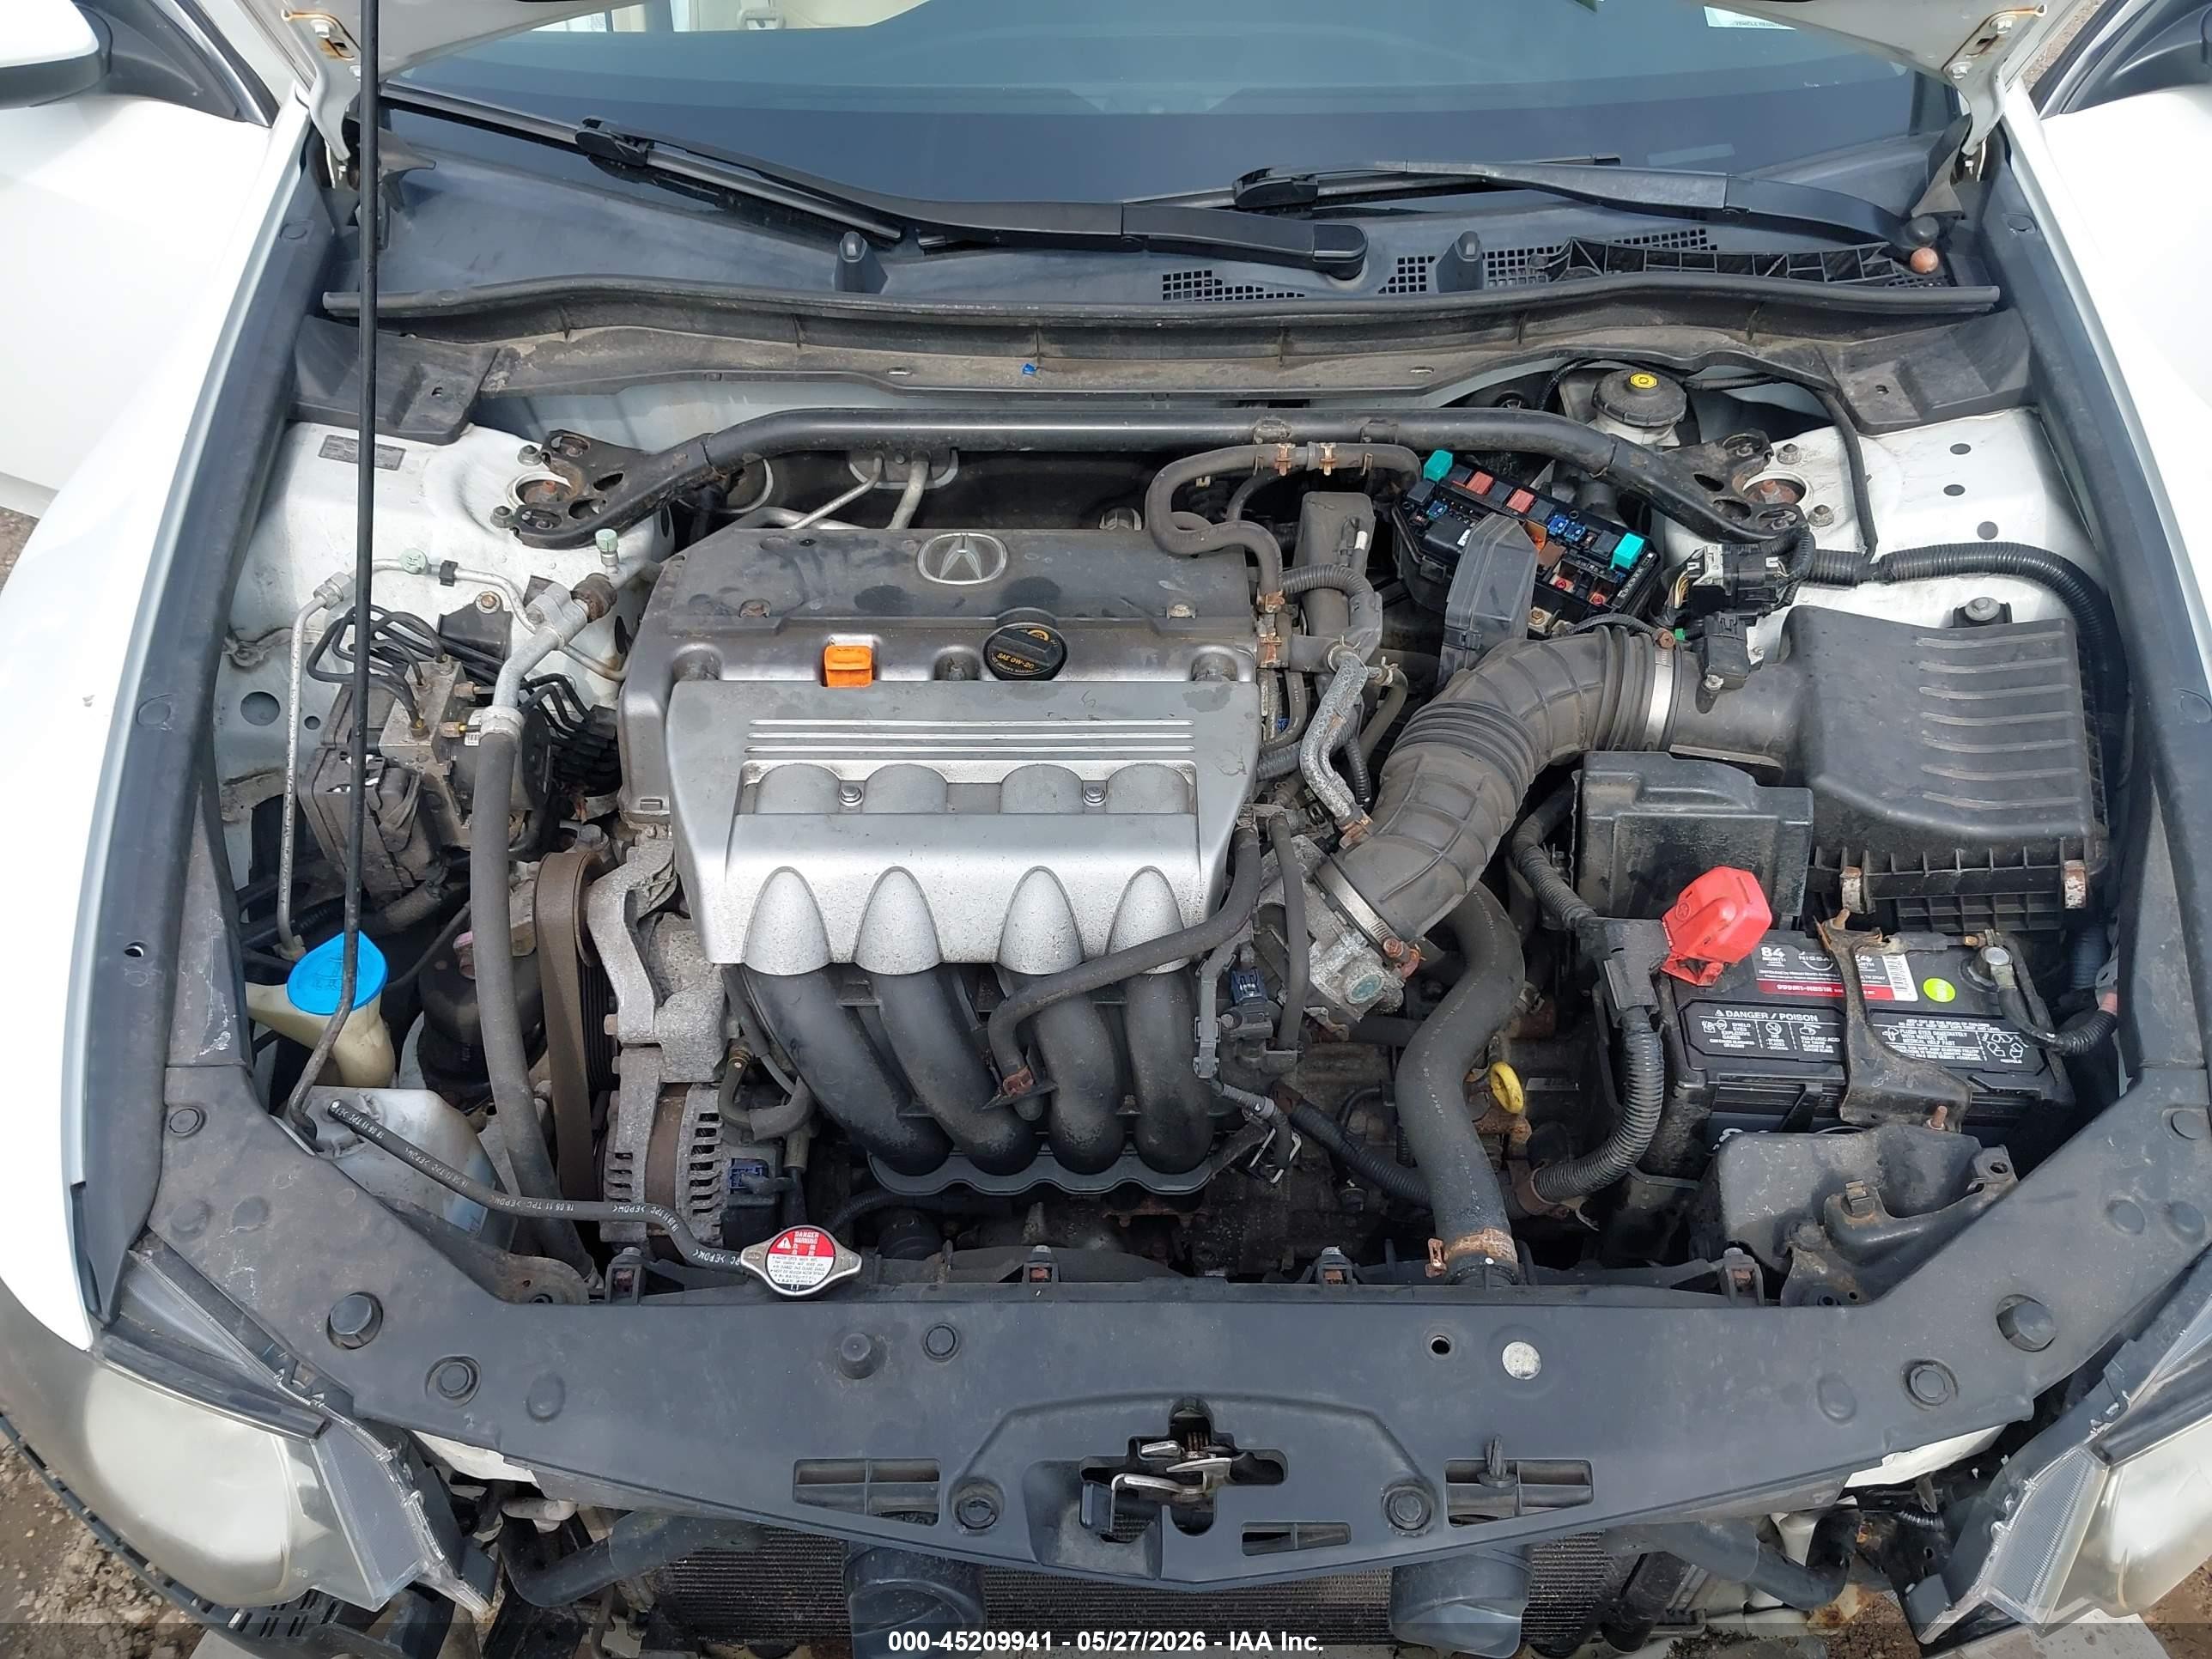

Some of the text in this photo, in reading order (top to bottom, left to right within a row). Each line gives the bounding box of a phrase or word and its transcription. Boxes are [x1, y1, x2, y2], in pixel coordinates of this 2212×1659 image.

[997, 653, 1035, 669] SAE 0W-20
[1760, 946, 1785, 957] 84
[1725, 1010, 1769, 1019] DANGER
[1779, 1013, 1819, 1022] POISON
[526, 1200, 543, 1210] TPC
